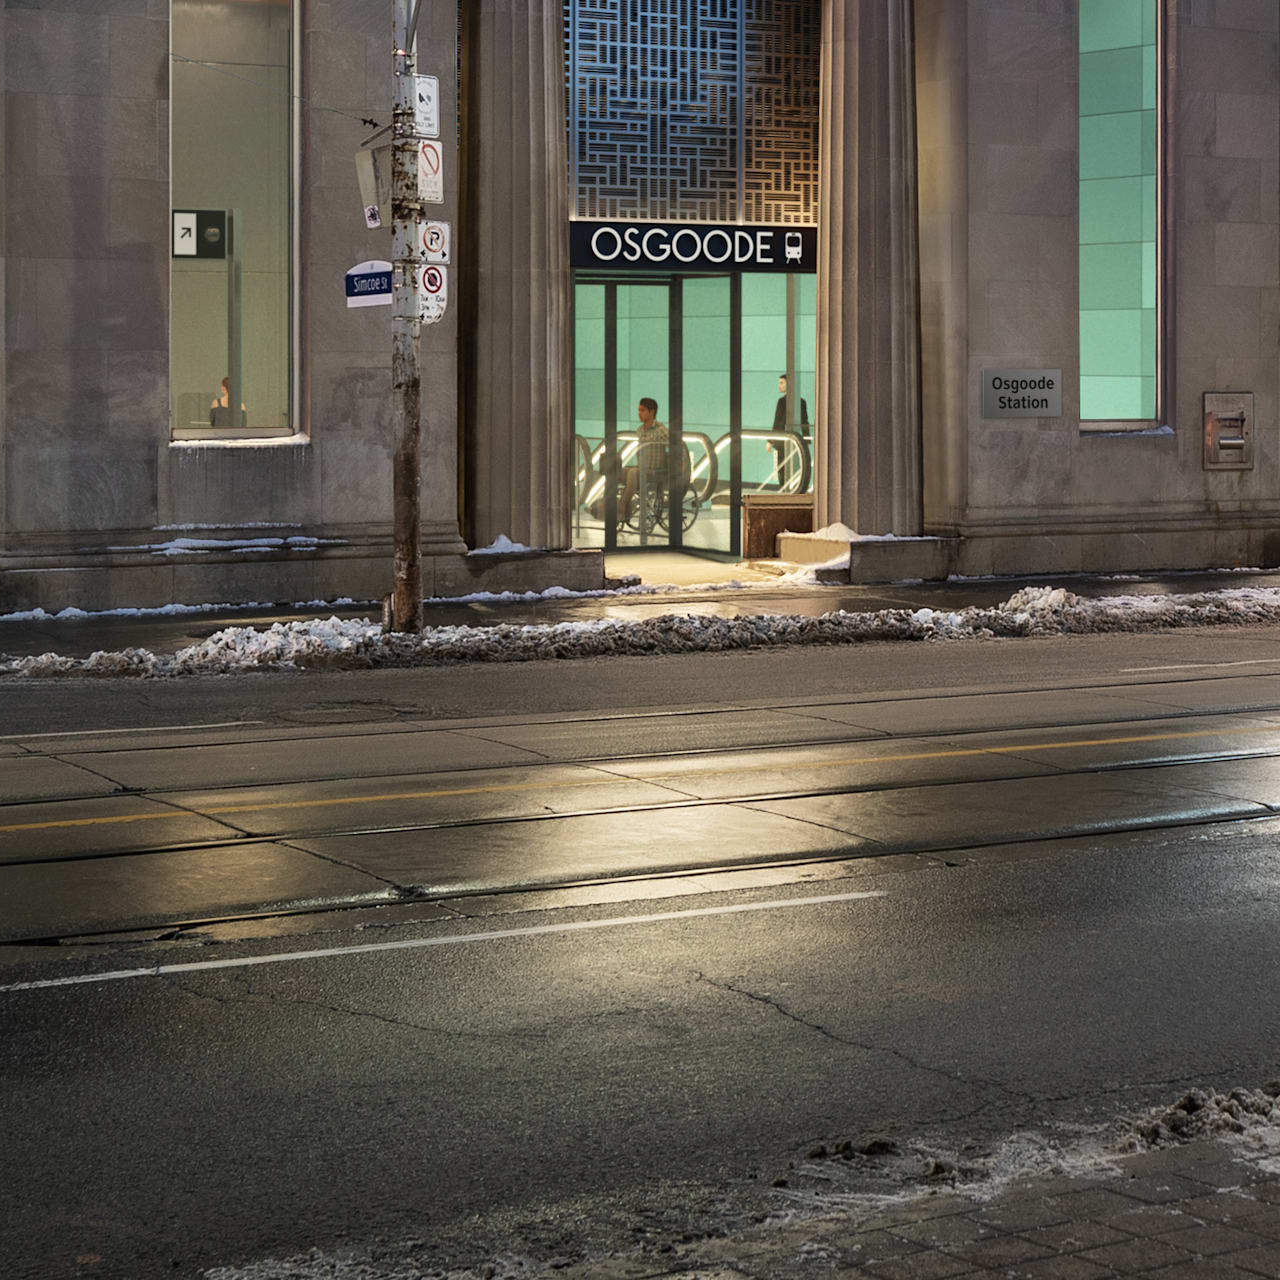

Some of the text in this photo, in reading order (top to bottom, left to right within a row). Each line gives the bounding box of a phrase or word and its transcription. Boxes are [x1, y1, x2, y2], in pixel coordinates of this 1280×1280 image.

[590, 226, 775, 264] OSGOODE
[353, 277, 380, 293] Simcoe
[991, 375, 1055, 394] Osgoode
[998, 395, 1049, 409] Station
